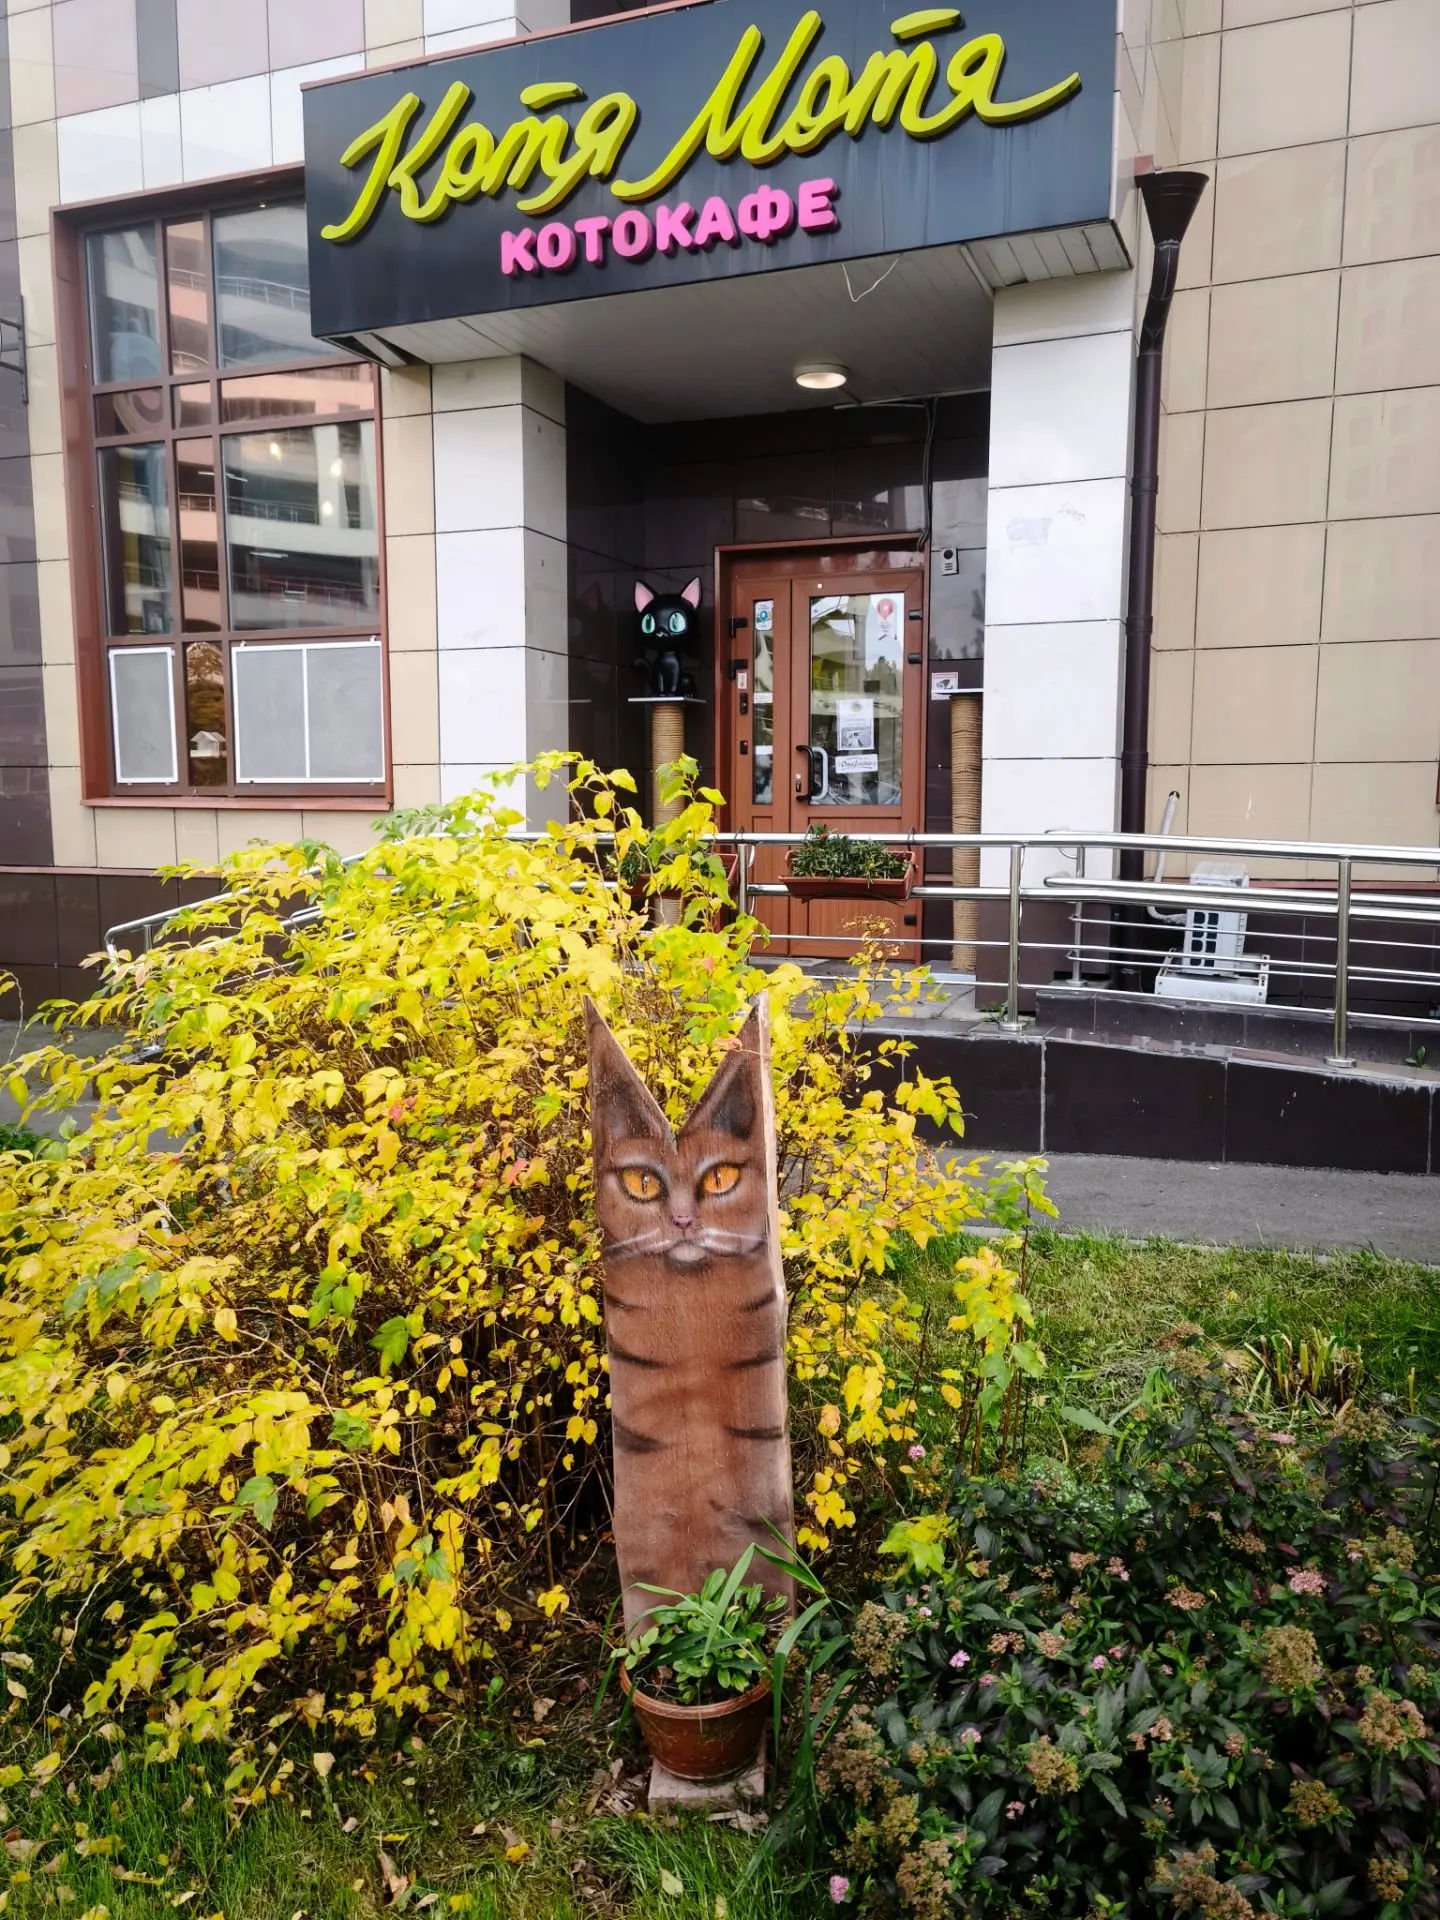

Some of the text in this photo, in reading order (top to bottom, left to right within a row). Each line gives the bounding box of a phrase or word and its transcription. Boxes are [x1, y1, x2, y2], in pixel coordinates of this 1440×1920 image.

[320, 9, 1081, 243] Котя Мотя
[500, 177, 838, 276] КОТОКАФЕ
